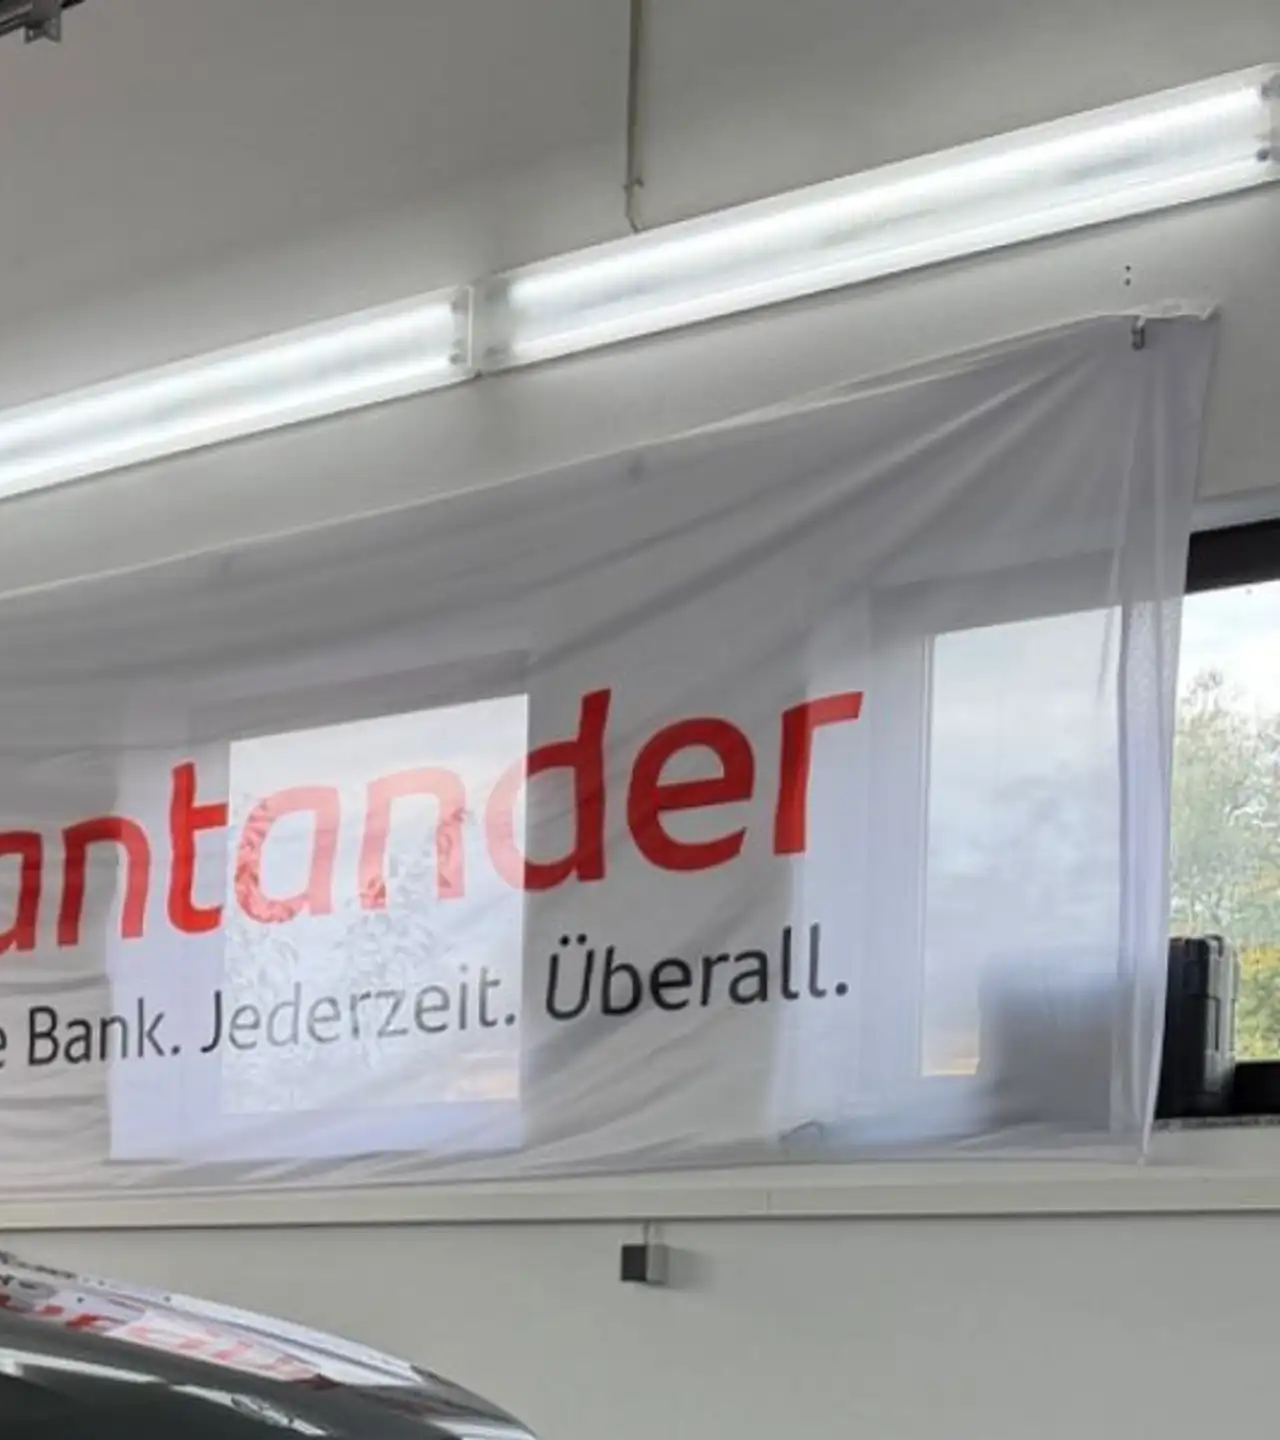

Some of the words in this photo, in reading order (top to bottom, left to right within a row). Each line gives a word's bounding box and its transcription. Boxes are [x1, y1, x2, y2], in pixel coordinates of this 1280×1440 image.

[26, 997, 181, 1068] Bank.
[200, 967, 517, 1054] Jederzeit.
[545, 923, 850, 1022] Überall.
